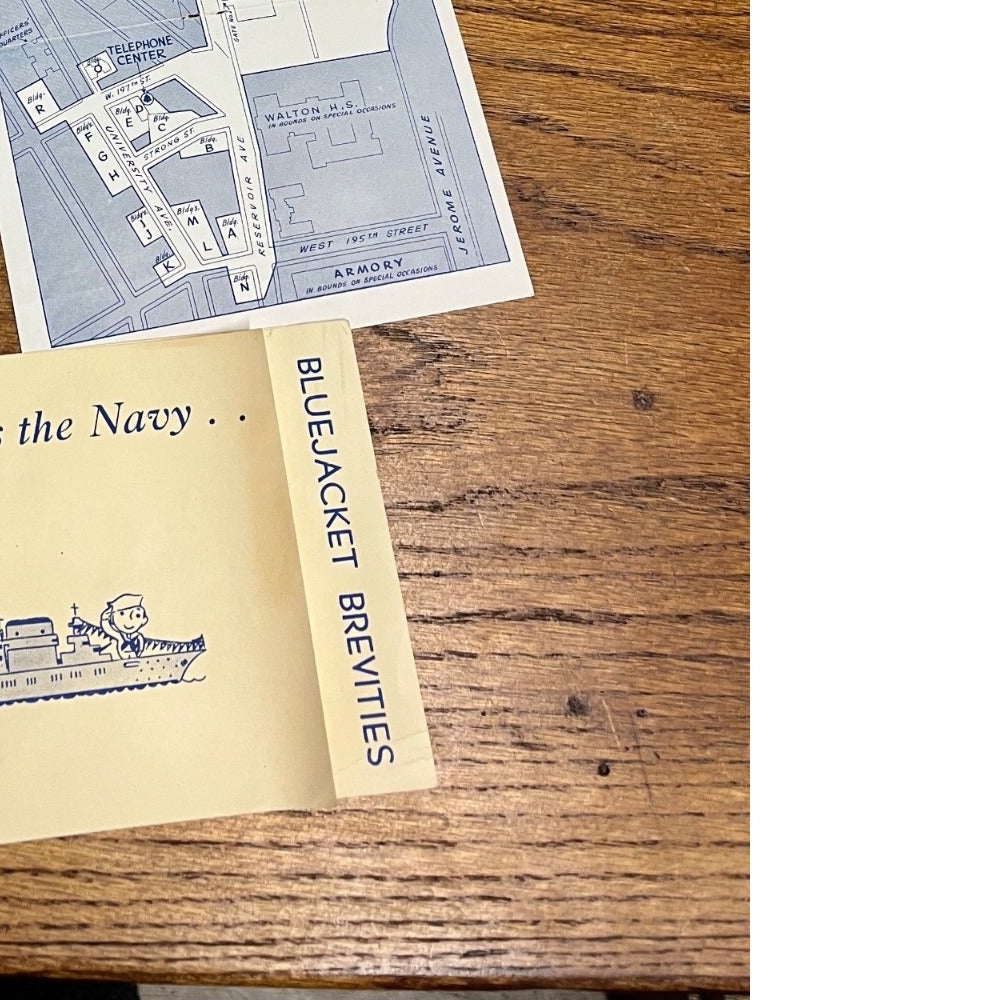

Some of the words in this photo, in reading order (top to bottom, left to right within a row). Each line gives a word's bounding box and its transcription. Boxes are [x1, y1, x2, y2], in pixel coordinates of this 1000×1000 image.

[107, 36, 173, 55] TELEPHONE
[117, 50, 166, 65] CENTER
[35, 105, 45, 114] R
[135, 105, 144, 113] D
[265, 106, 320, 122] WALTON
[330, 101, 357, 111] H.S.
[279, 118, 307, 127] BOUNDS
[323, 110, 353, 119] SPECIAL
[357, 103, 396, 114] OCCASIONS
[143, 137, 180, 160] STRONG
[237, 136, 247, 162] AVE
[421, 115, 446, 176] AVENUE
[105, 126, 152, 193] UNIVERSITY
[187, 217, 199, 226] M
[245, 177, 266, 256] RESERVOIR
[442, 189, 468, 255] JEROME
[228, 228, 236, 238] A
[300, 240, 333, 253] WEST
[387, 224, 428, 237] STREET
[317, 281, 347, 292] BOUNDS
[364, 272, 393, 284] SPECIAL
[397, 265, 438, 277] OCCASIONS
[334, 258, 403, 278] ARMORY
[240, 282, 249, 292] N
[18, 413, 73, 446] the
[90, 400, 192, 440] Navy
[297, 356, 358, 569] BLUEJACKET
[338, 593, 394, 768] BREVITIES
